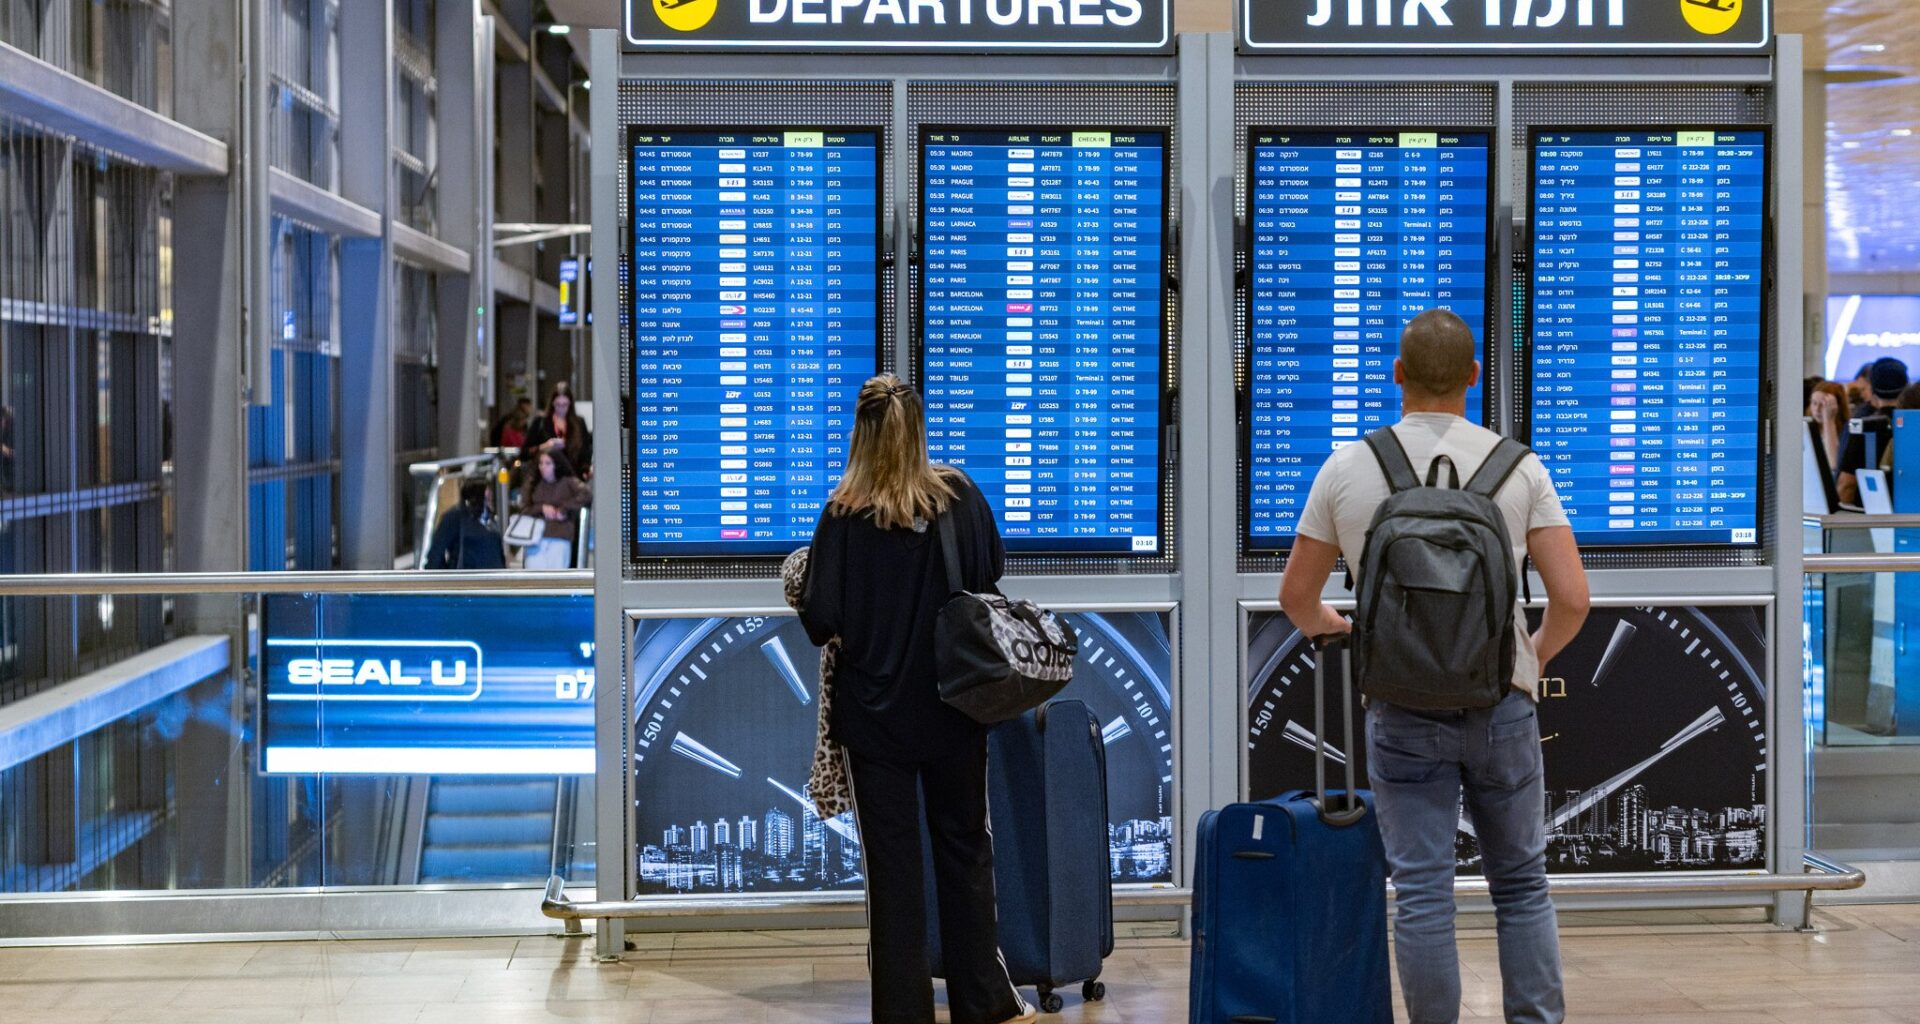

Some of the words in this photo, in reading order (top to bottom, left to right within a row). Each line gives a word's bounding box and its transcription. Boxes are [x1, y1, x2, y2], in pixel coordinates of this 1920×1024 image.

[1008, 135, 1030, 143] AIRLINE
[1041, 135, 1061, 143] FLIGHT
[827, 151, 841, 160] בזמן
[1114, 151, 1123, 159] ON
[1125, 151, 1138, 159] TIME
[1280, 151, 1299, 159] לרנקה
[1440, 152, 1454, 160] בזמן
[1560, 178, 1575, 187] ציריך
[1717, 178, 1730, 186] בזמן
[950, 220, 976, 228] LARNACA
[1113, 221, 1122, 229] ON
[1123, 221, 1137, 229] TIME
[661, 236, 691, 245] פרנקפורט
[827, 236, 841, 245] בזמן
[950, 234, 967, 242] PARIS
[950, 290, 984, 298] BARCELONA
[662, 334, 676, 344] לוטון
[677, 334, 694, 344] לונדון
[1277, 332, 1298, 341] סלוניקי
[949, 346, 973, 354] MUNICH
[1557, 343, 1578, 352] הרקליון
[662, 391, 678, 399] ורשה
[828, 391, 841, 399] בזמן
[949, 402, 974, 410] WARSAW
[1111, 402, 1120, 410] ON
[1121, 402, 1135, 410] TIME
[1556, 412, 1572, 420] אבבה
[1573, 412, 1588, 420] אדיס
[1109, 526, 1119, 534] ON
[1120, 526, 1133, 534] TIME
[664, 531, 683, 539] מדריד
[287, 658, 421, 686] SEAL
[431, 659, 466, 686] U
[555, 668, 595, 701] לם
[1731, 691, 1747, 709] 10
[1136, 700, 1153, 719] 10
[1255, 709, 1272, 730] 50
[643, 722, 662, 742] 50
